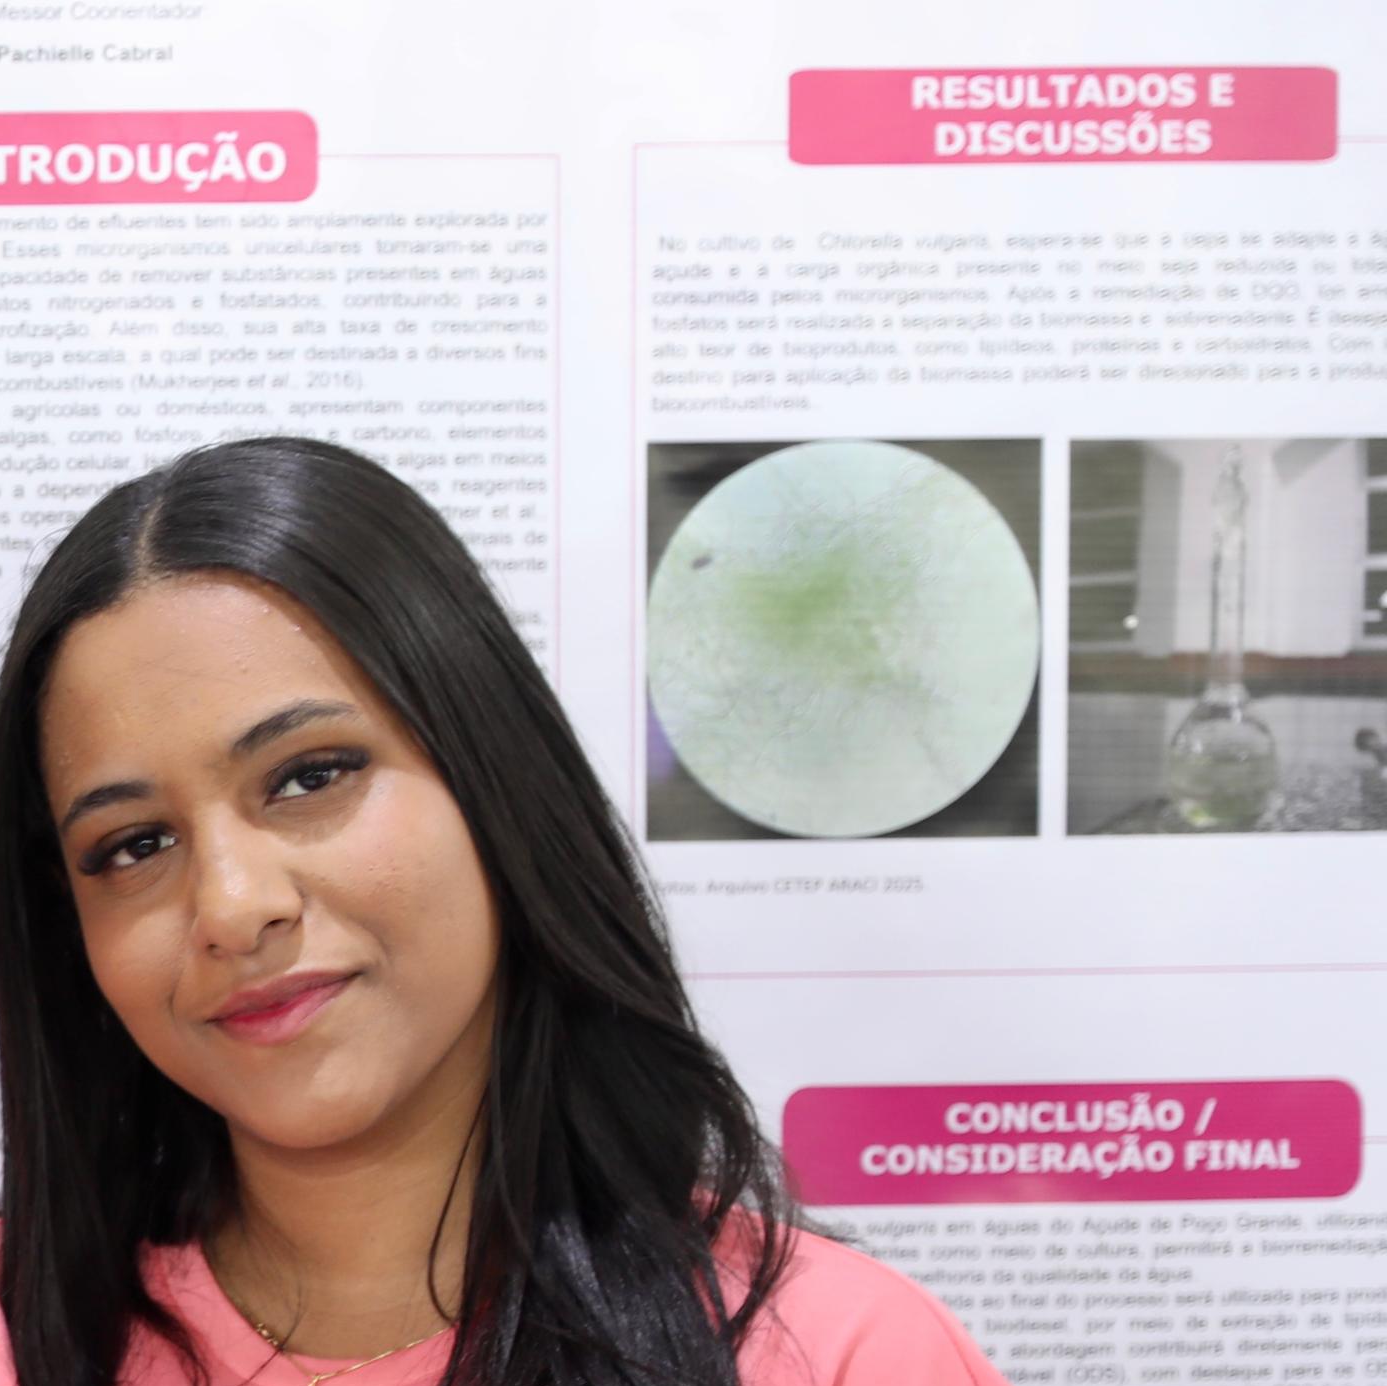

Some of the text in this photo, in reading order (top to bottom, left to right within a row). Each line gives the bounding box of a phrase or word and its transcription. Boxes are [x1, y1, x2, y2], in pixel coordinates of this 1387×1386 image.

[911, 73, 1235, 109] RESULTADOS E
[934, 111, 1213, 155] DISCUSSÕES
[945, 1092, 1217, 1136] CONCLUSÃO /
[861, 1135, 1300, 1179] CONSIDERAÇÃO FINAL
